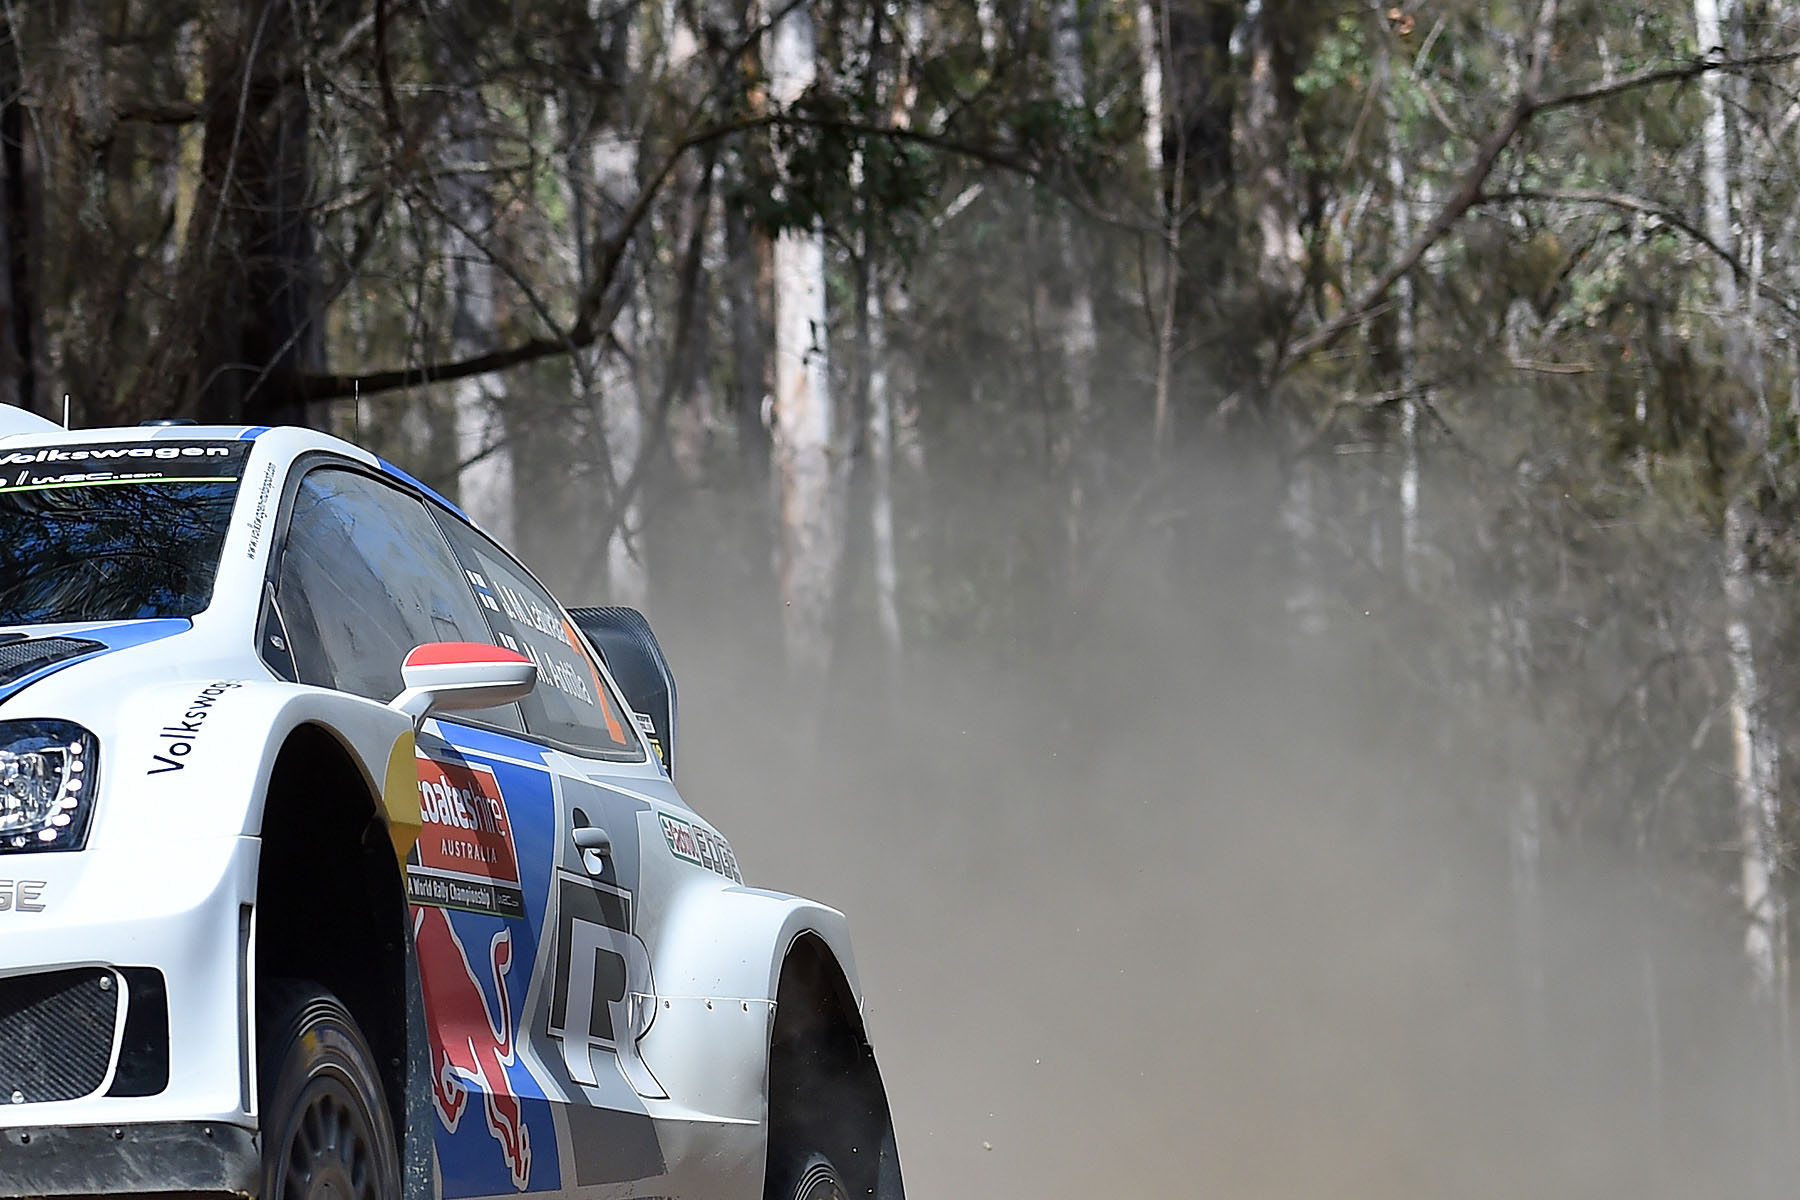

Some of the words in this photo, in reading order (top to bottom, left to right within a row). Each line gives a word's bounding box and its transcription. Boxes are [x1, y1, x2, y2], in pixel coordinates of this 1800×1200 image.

[440, 838, 498, 865] AUSTRALIA
[691, 823, 743, 886] EDGE
[412, 877, 433, 897] World
[432, 880, 449, 903] Rally
[449, 882, 491, 910] Championship
